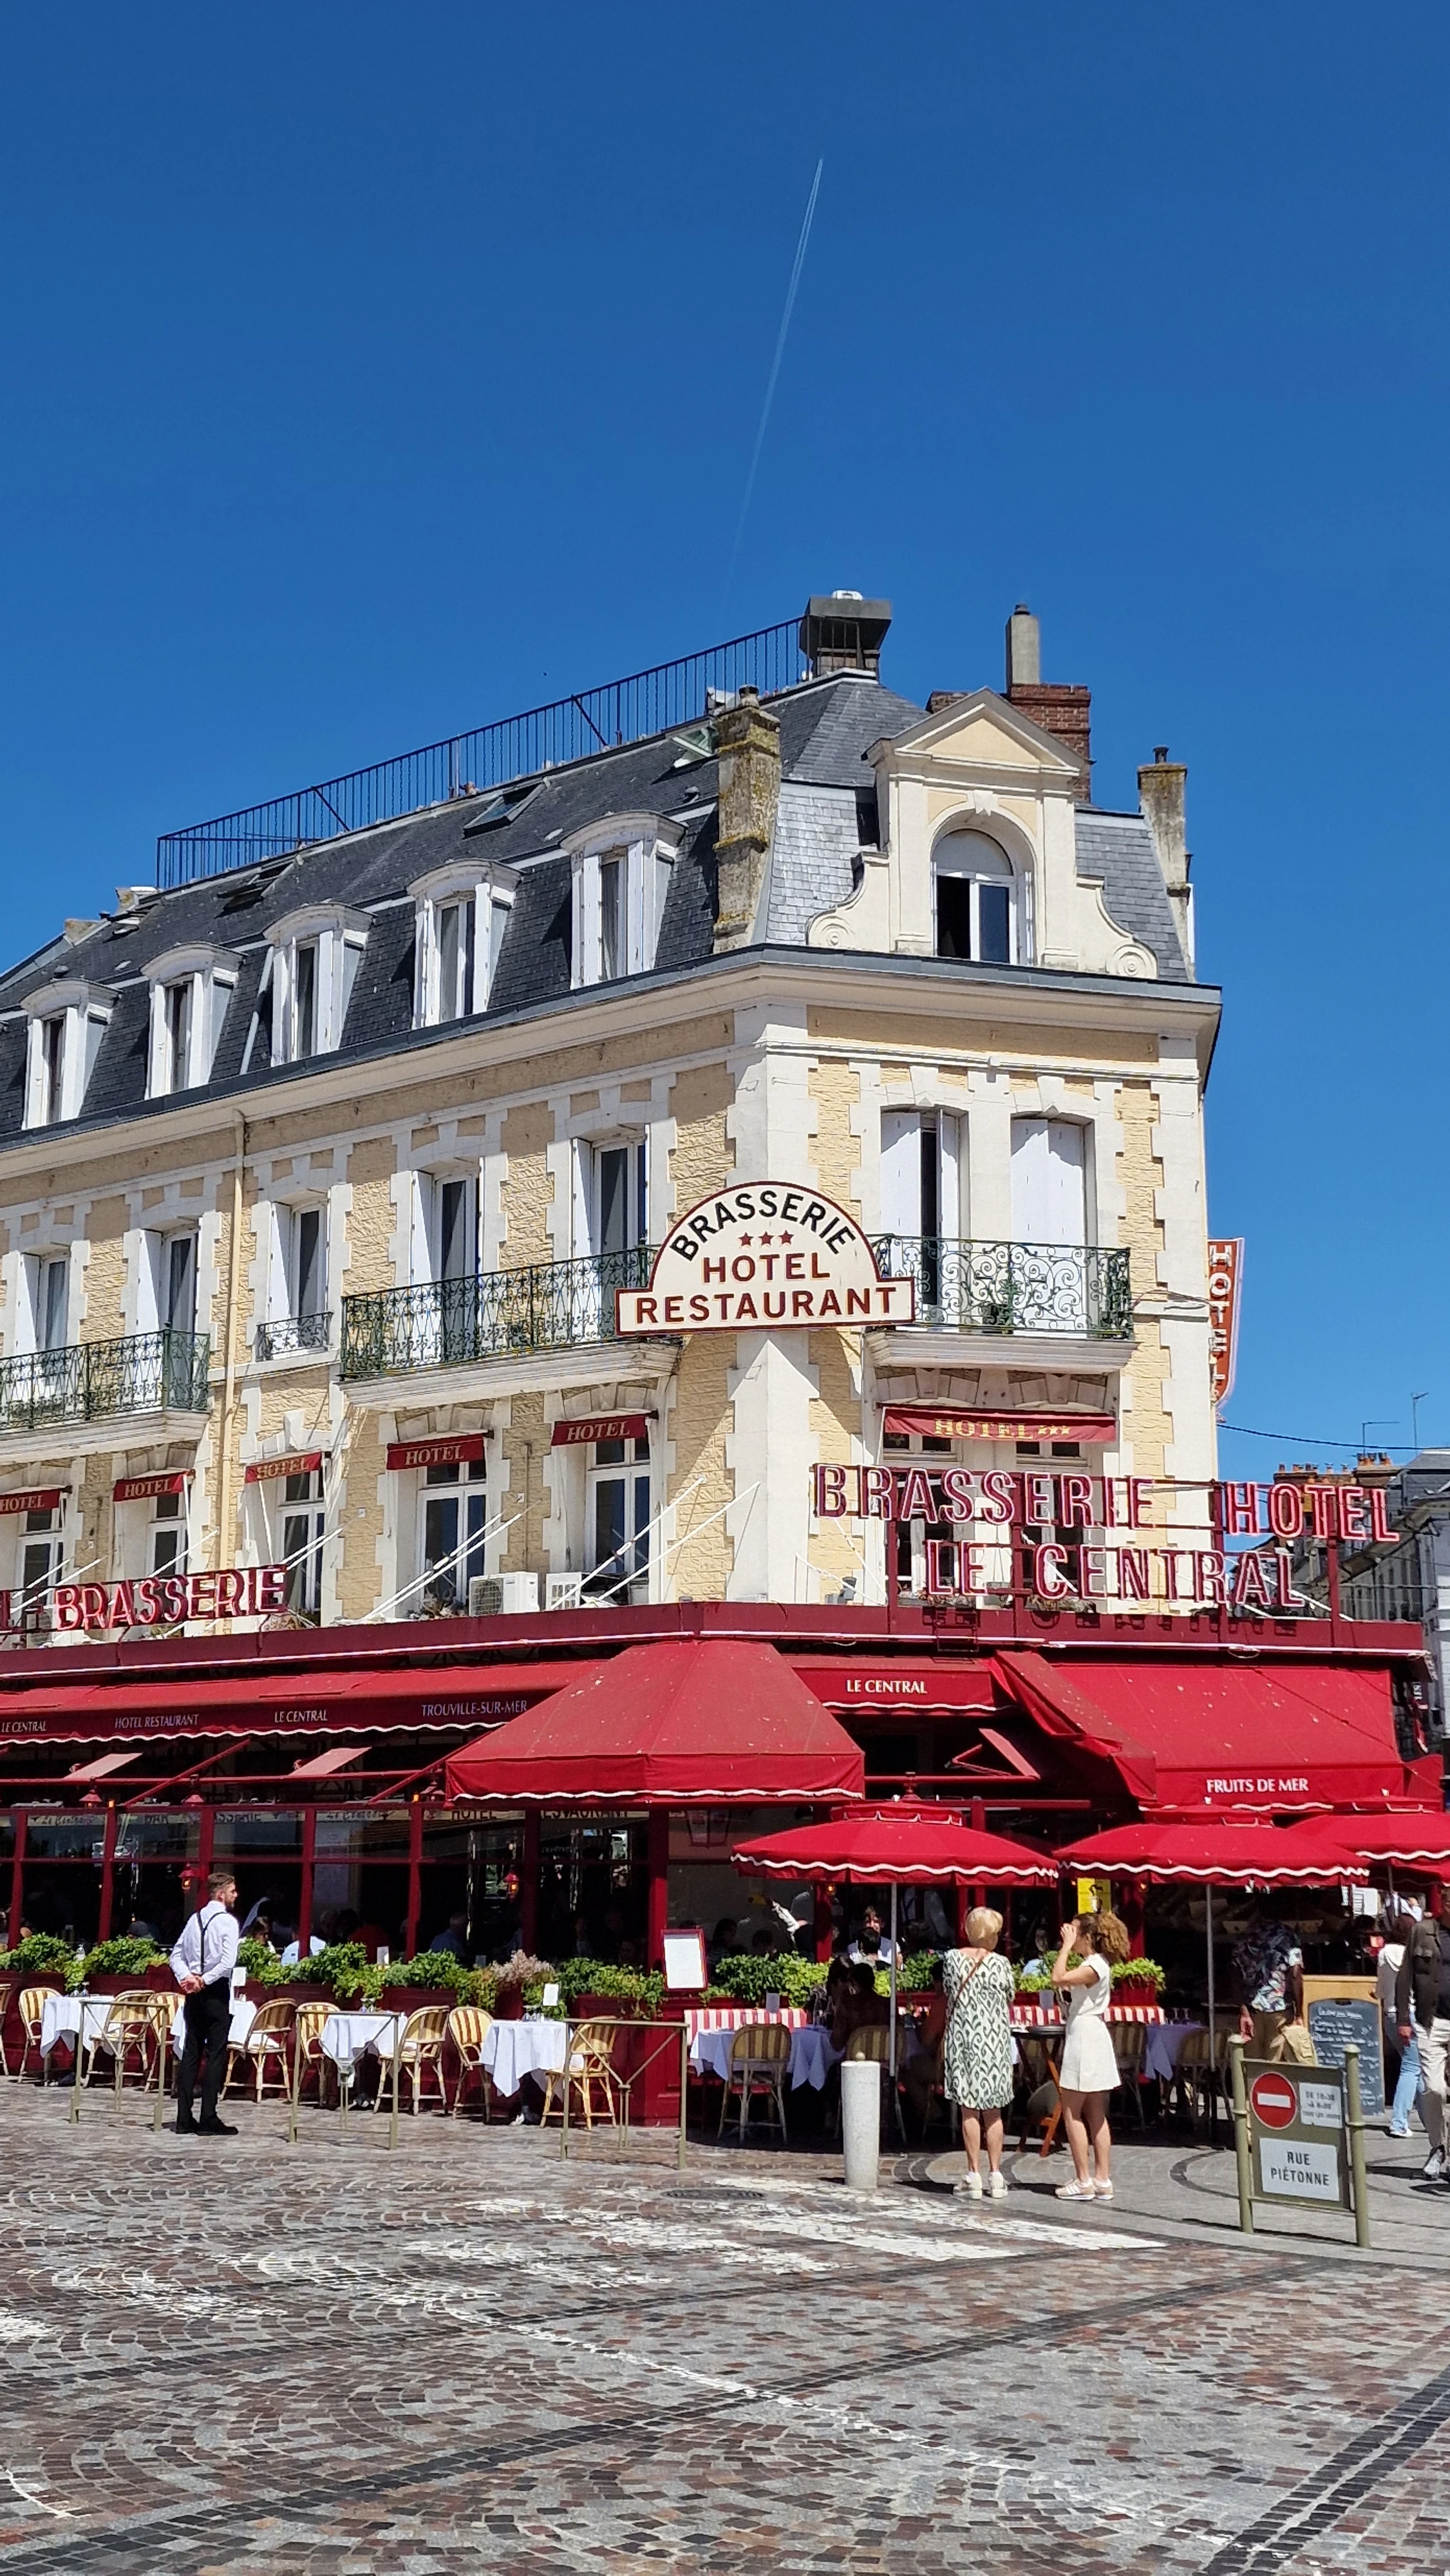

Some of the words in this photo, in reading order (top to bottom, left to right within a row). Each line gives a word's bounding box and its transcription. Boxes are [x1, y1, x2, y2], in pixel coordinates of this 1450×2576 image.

[670, 1190, 856, 1261] BRASSERIE
[702, 1252, 831, 1283] HOTEL
[636, 1287, 897, 1325] RESTAURANT
[567, 1421, 630, 1441] HOTEL
[934, 1419, 1034, 1439] HOTEL
[405, 1445, 464, 1465] HOTEL
[257, 1457, 309, 1479] HOTEL
[124, 1479, 172, 1498] HOTEL
[0, 1495, 45, 1511] HOTEL
[813, 1463, 1155, 1529] BRASSERIE
[1225, 1481, 1401, 1542] HOTEL
[925, 1539, 988, 1596] LE
[1033, 1543, 1306, 1608] CENTRAL
[53, 1564, 288, 1632] BRASSERIE
[847, 1680, 862, 1692] LE
[865, 1680, 928, 1694] CENTRAL
[275, 1711, 285, 1723] LE
[286, 1709, 328, 1722] CENTRAL
[422, 1700, 527, 1717] TROUVILLE-SUR-MER
[1, 1721, 12, 1733] LE
[12, 1721, 47, 1732] CENTRAL
[115, 1716, 142, 1729] HOTEL
[144, 1714, 200, 1728] RESTAURANT
[1207, 1779, 1255, 1793] FRUITS
[1256, 1778, 1276, 1792] DE
[1279, 1777, 1310, 1792] MER
[1287, 2151, 1311, 2166] RUE
[1270, 2167, 1330, 2186] PIÉTONNE
